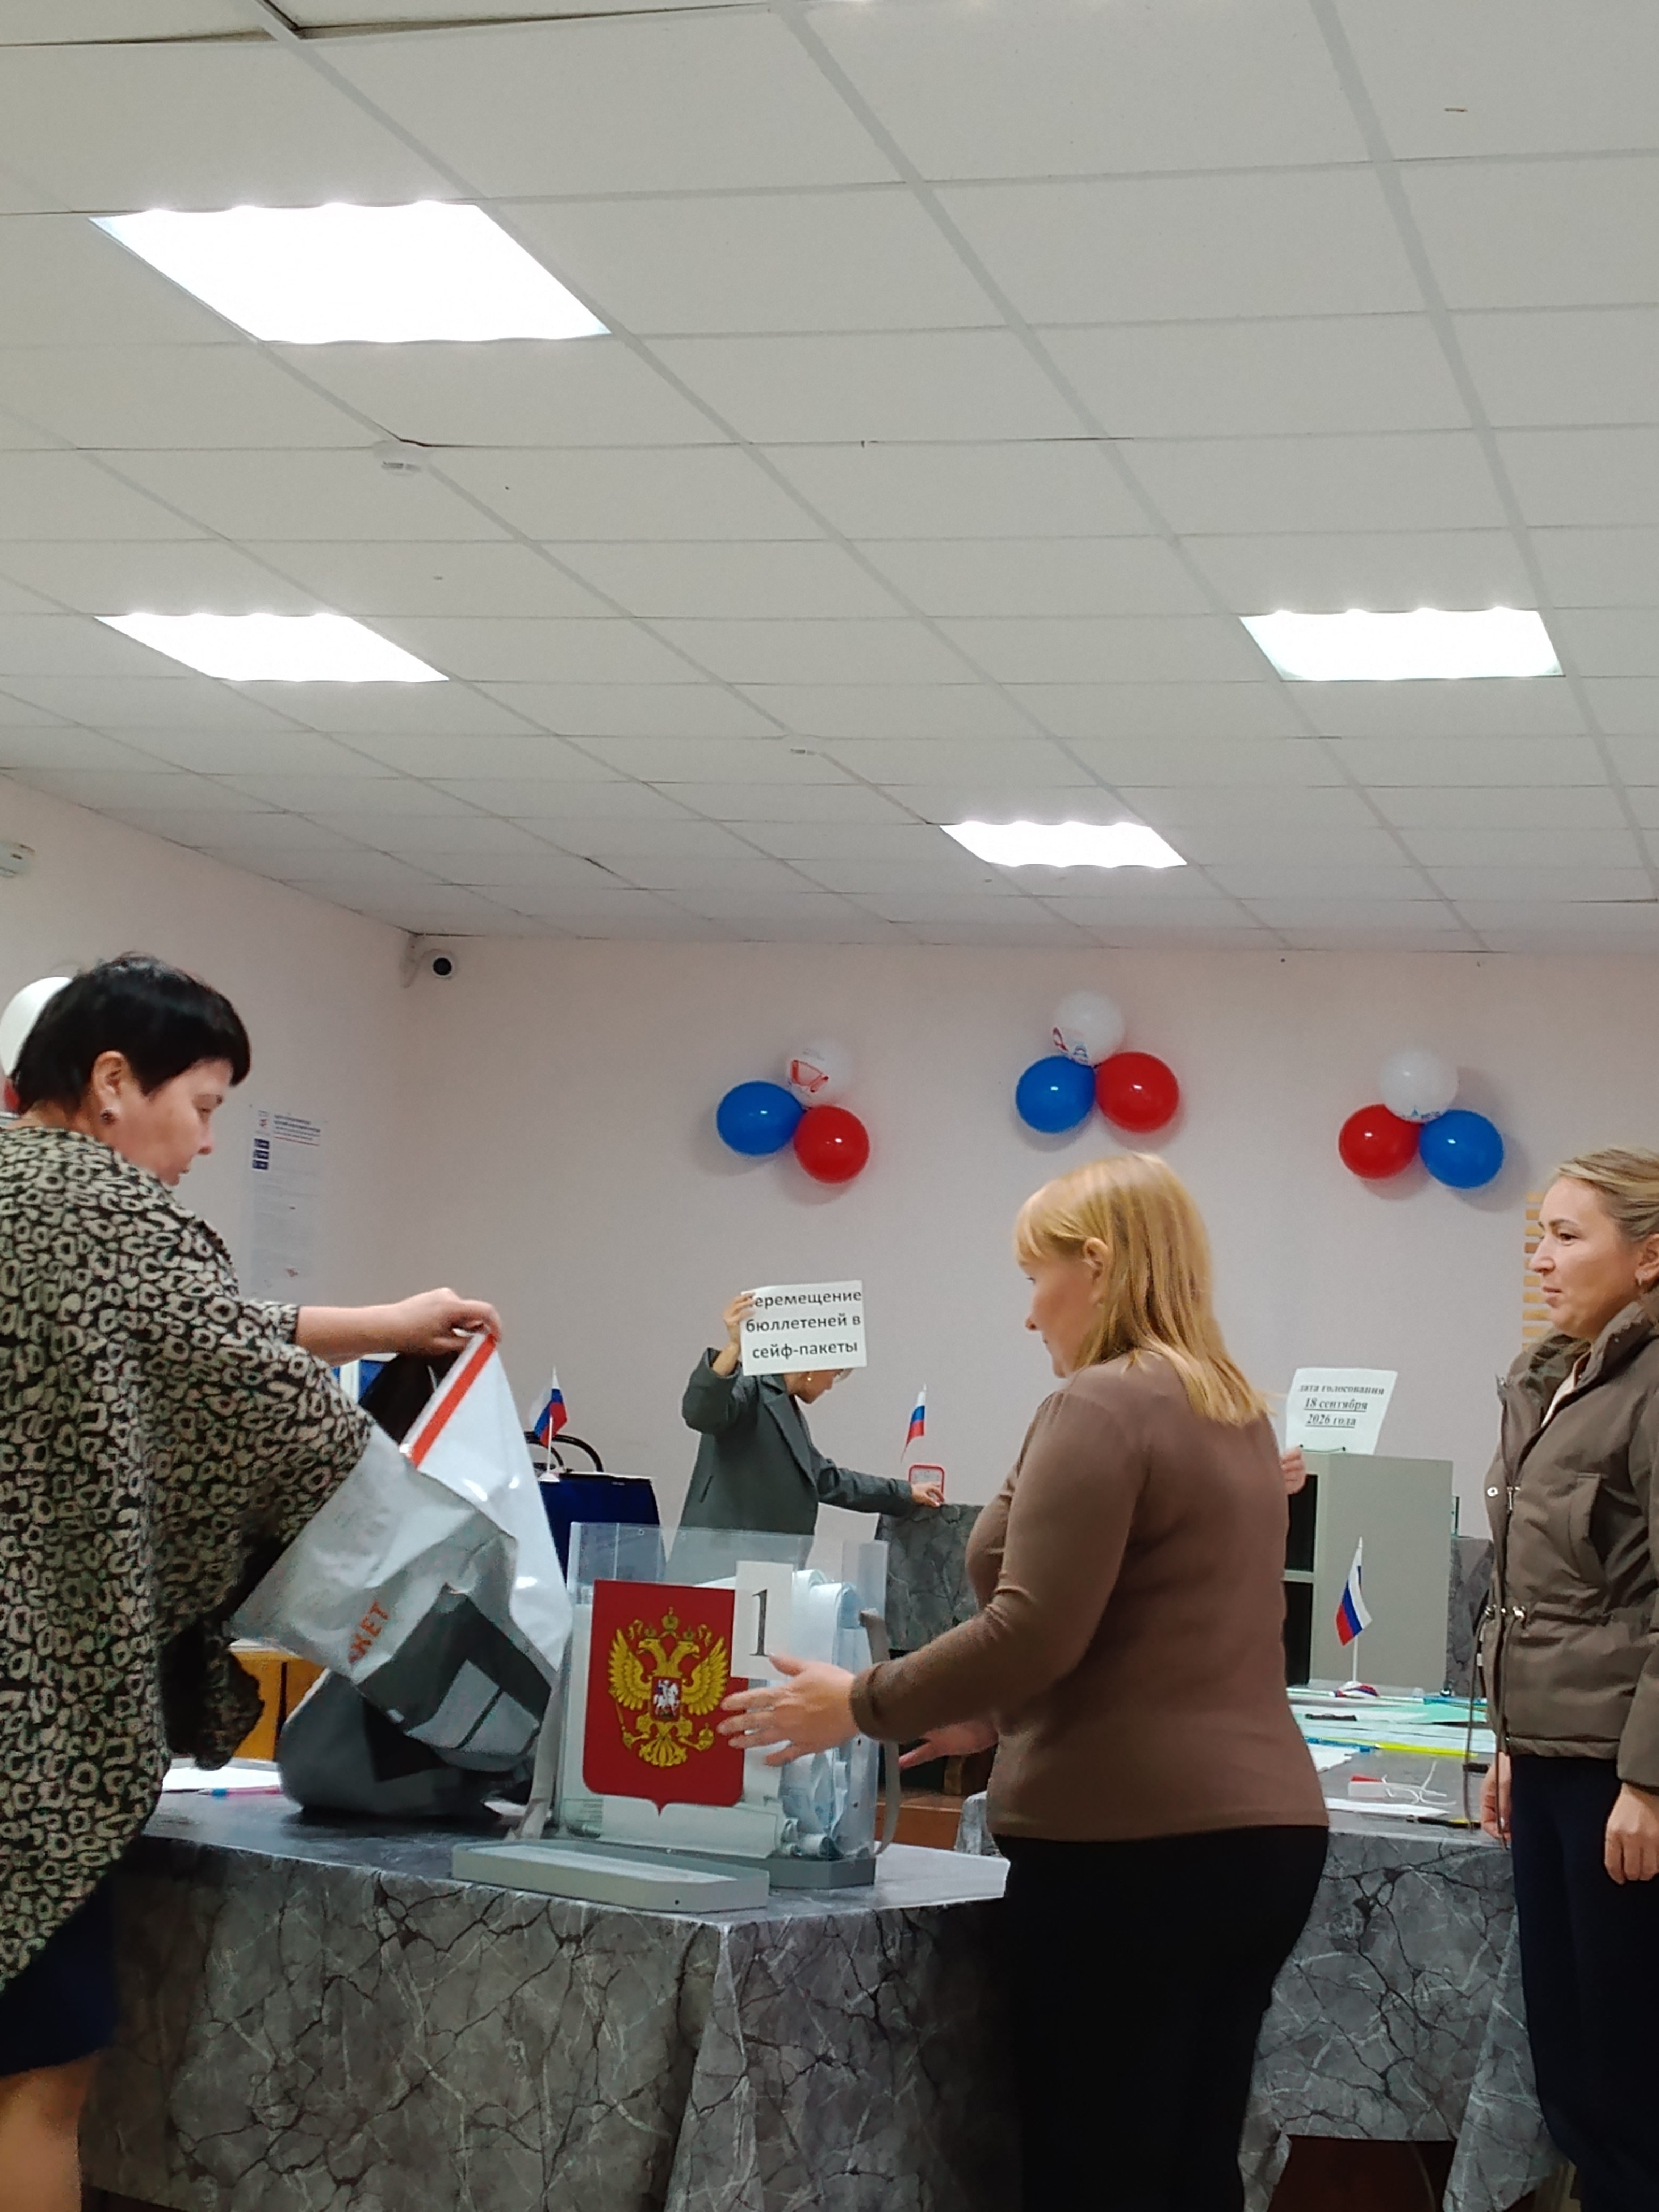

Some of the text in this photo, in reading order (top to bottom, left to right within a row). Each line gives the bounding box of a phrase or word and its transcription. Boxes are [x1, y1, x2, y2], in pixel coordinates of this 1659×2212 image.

[751, 1291, 862, 1309] еремещение
[745, 1313, 860, 1333] бюллетеней в
[752, 1342, 858, 1359] сейф-пакеты
[1305, 1397, 1368, 1411] 18 сентября
[1306, 1414, 1330, 1425] 2026
[749, 1589, 768, 1657] 1
